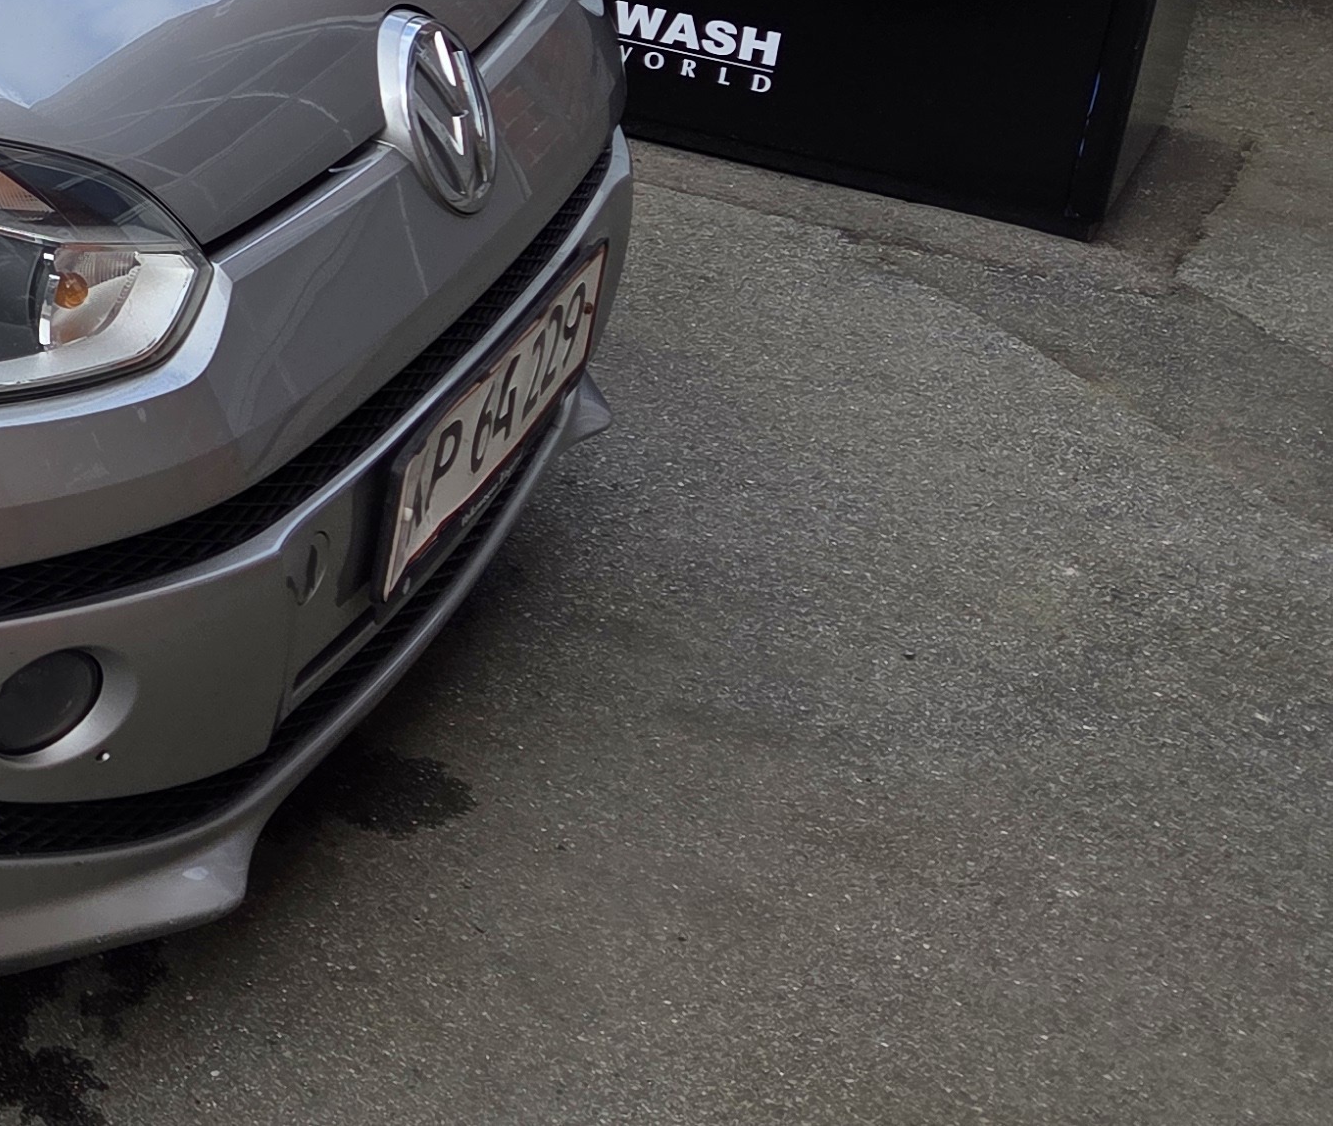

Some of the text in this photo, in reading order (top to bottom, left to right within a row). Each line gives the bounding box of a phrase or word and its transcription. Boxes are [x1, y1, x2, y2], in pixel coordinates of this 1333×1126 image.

[615, 0, 781, 66] WASH
[471, 354, 521, 474] 64
[522, 282, 586, 422] 229
